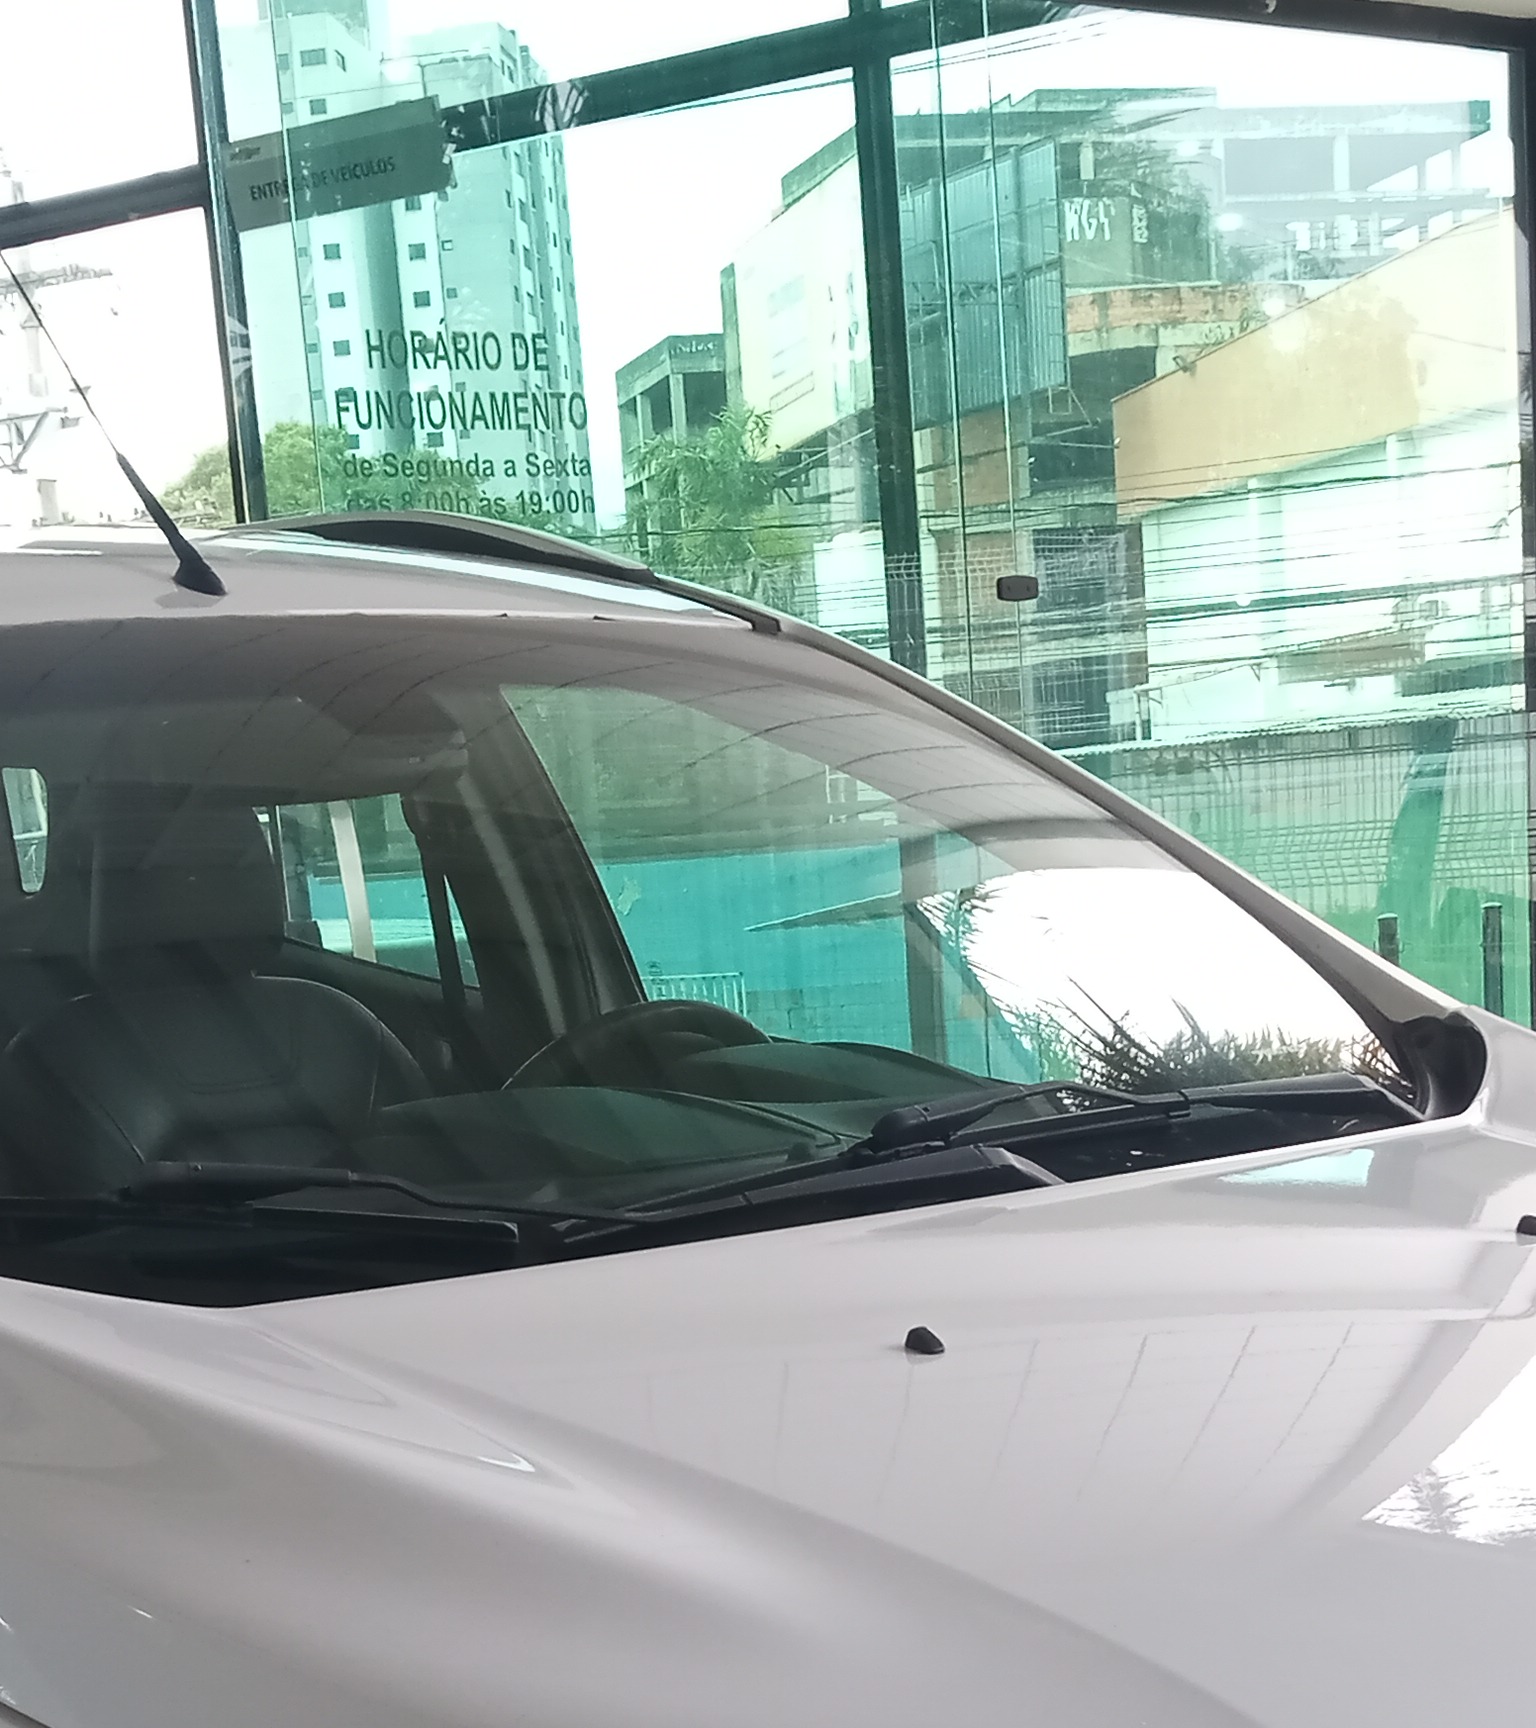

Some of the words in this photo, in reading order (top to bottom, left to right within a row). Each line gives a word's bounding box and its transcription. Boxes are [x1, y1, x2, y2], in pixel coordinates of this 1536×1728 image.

[249, 174, 310, 200] ENTREA
[311, 168, 328, 188] DE
[365, 317, 502, 370] HORÁRIO
[511, 331, 550, 371] DE
[335, 389, 588, 431] FUNCIONAMENTO
[343, 452, 373, 478] de
[382, 452, 495, 483] Segunda
[503, 459, 518, 478] a
[525, 452, 592, 478] Sexta
[479, 489, 507, 515] às
[516, 488, 596, 515] 19:00h
